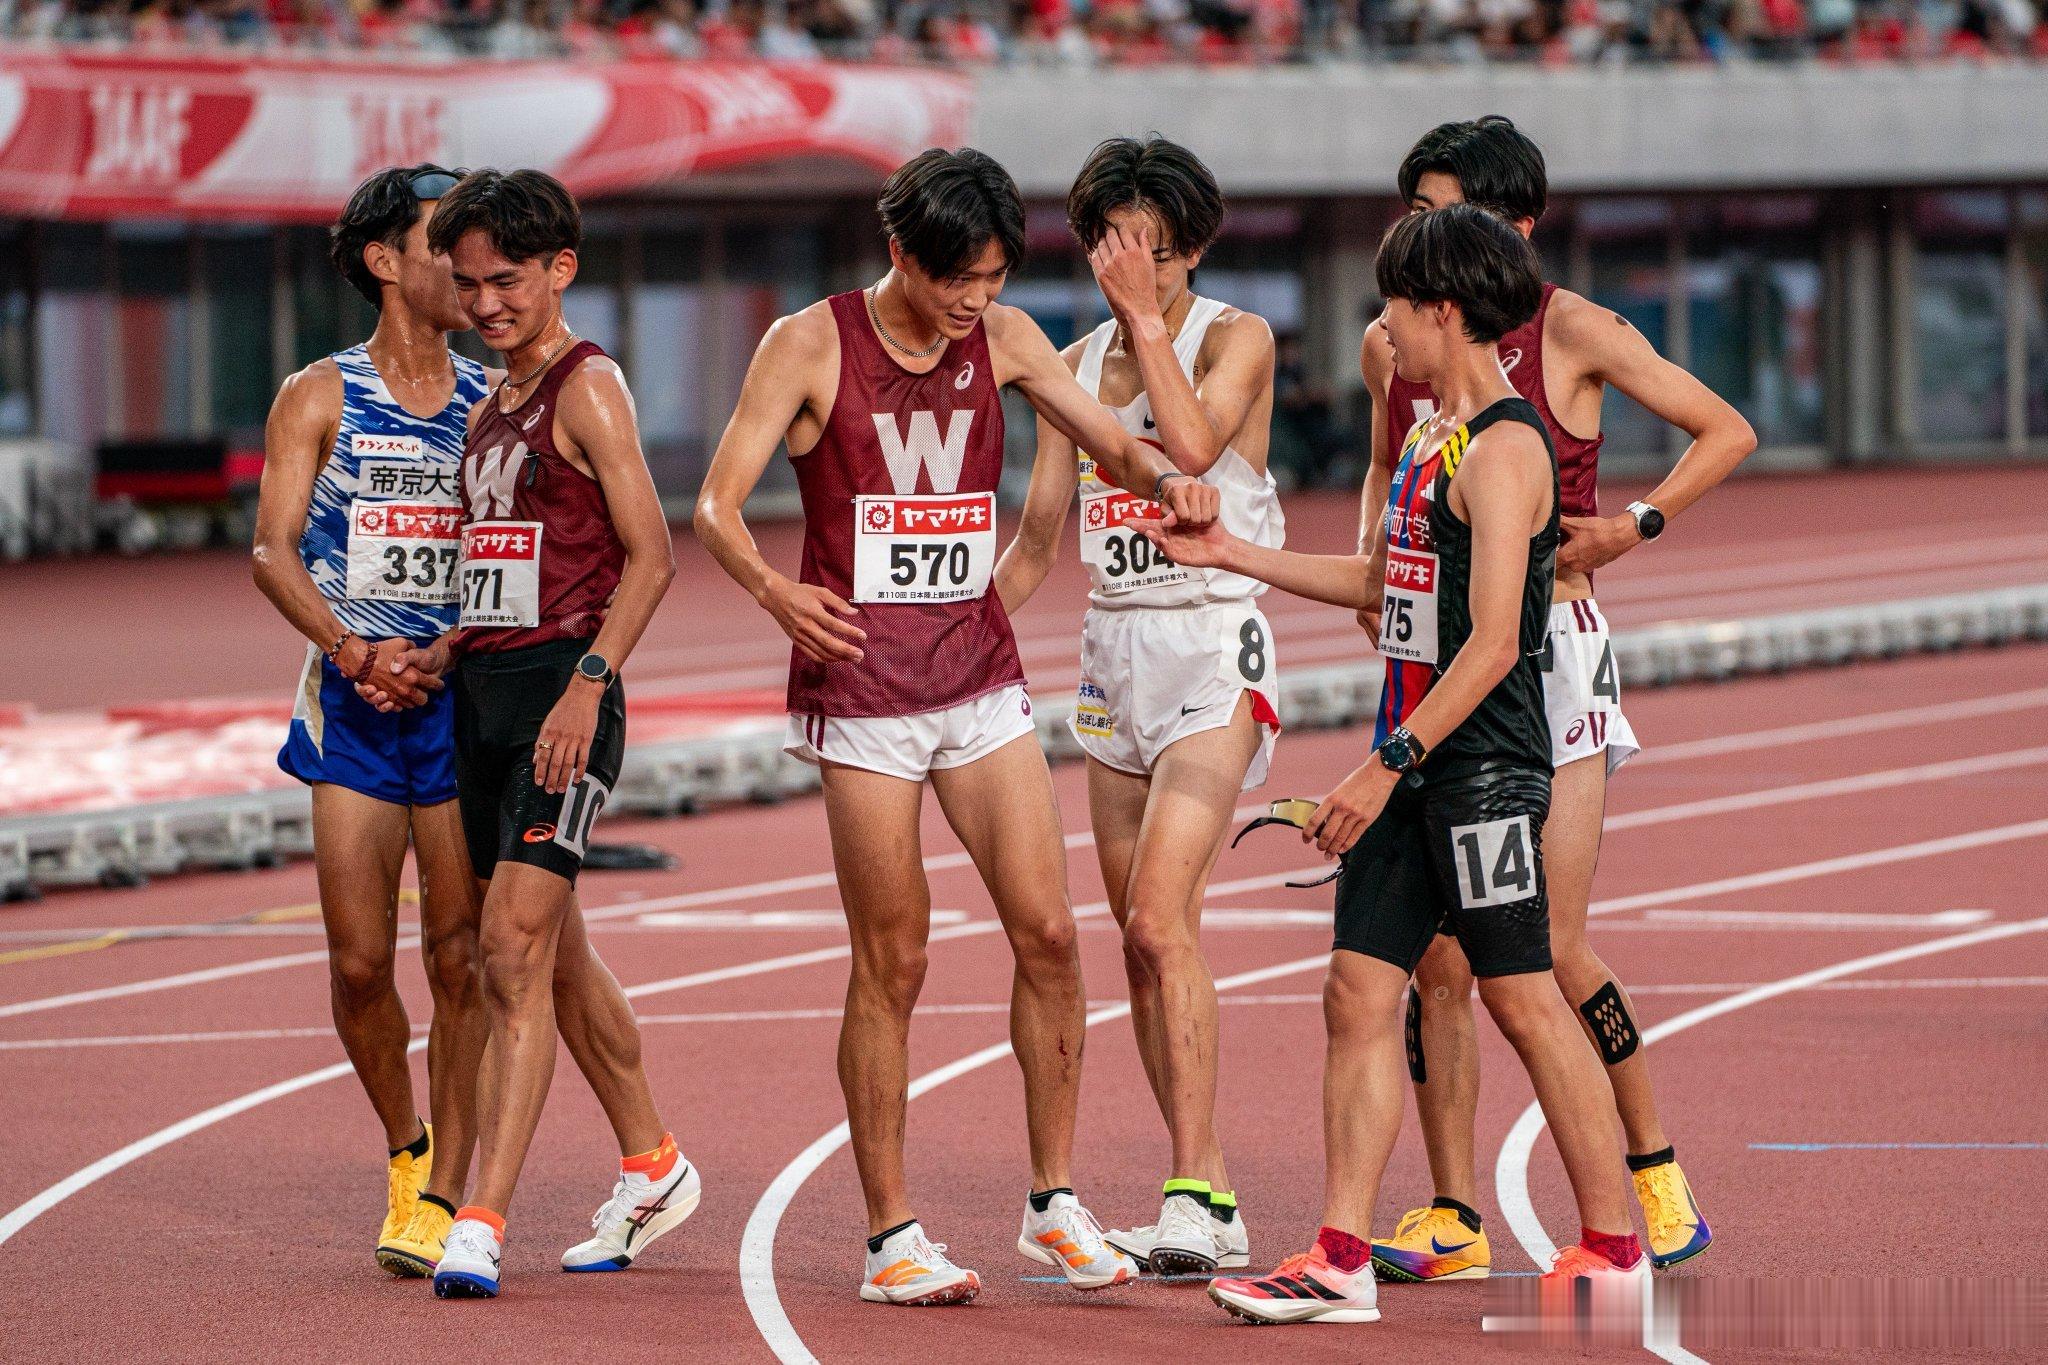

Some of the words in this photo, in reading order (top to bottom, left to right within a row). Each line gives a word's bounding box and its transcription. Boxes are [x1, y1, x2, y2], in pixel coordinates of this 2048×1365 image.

[871, 409, 975, 495] W
[465, 441, 529, 522] W
[393, 512, 467, 532] ヤマザ
[901, 505, 986, 528] ヤマザキ
[1111, 501, 1160, 520] ヤマ
[383, 545, 459, 588] 337
[890, 541, 969, 587] 570
[462, 568, 503, 611] 571
[878, 591, 908, 599] 第110回
[1238, 617, 1265, 682] 8
[1592, 638, 1618, 705] 4
[564, 779, 606, 851] 10
[1457, 822, 1532, 900] 14
